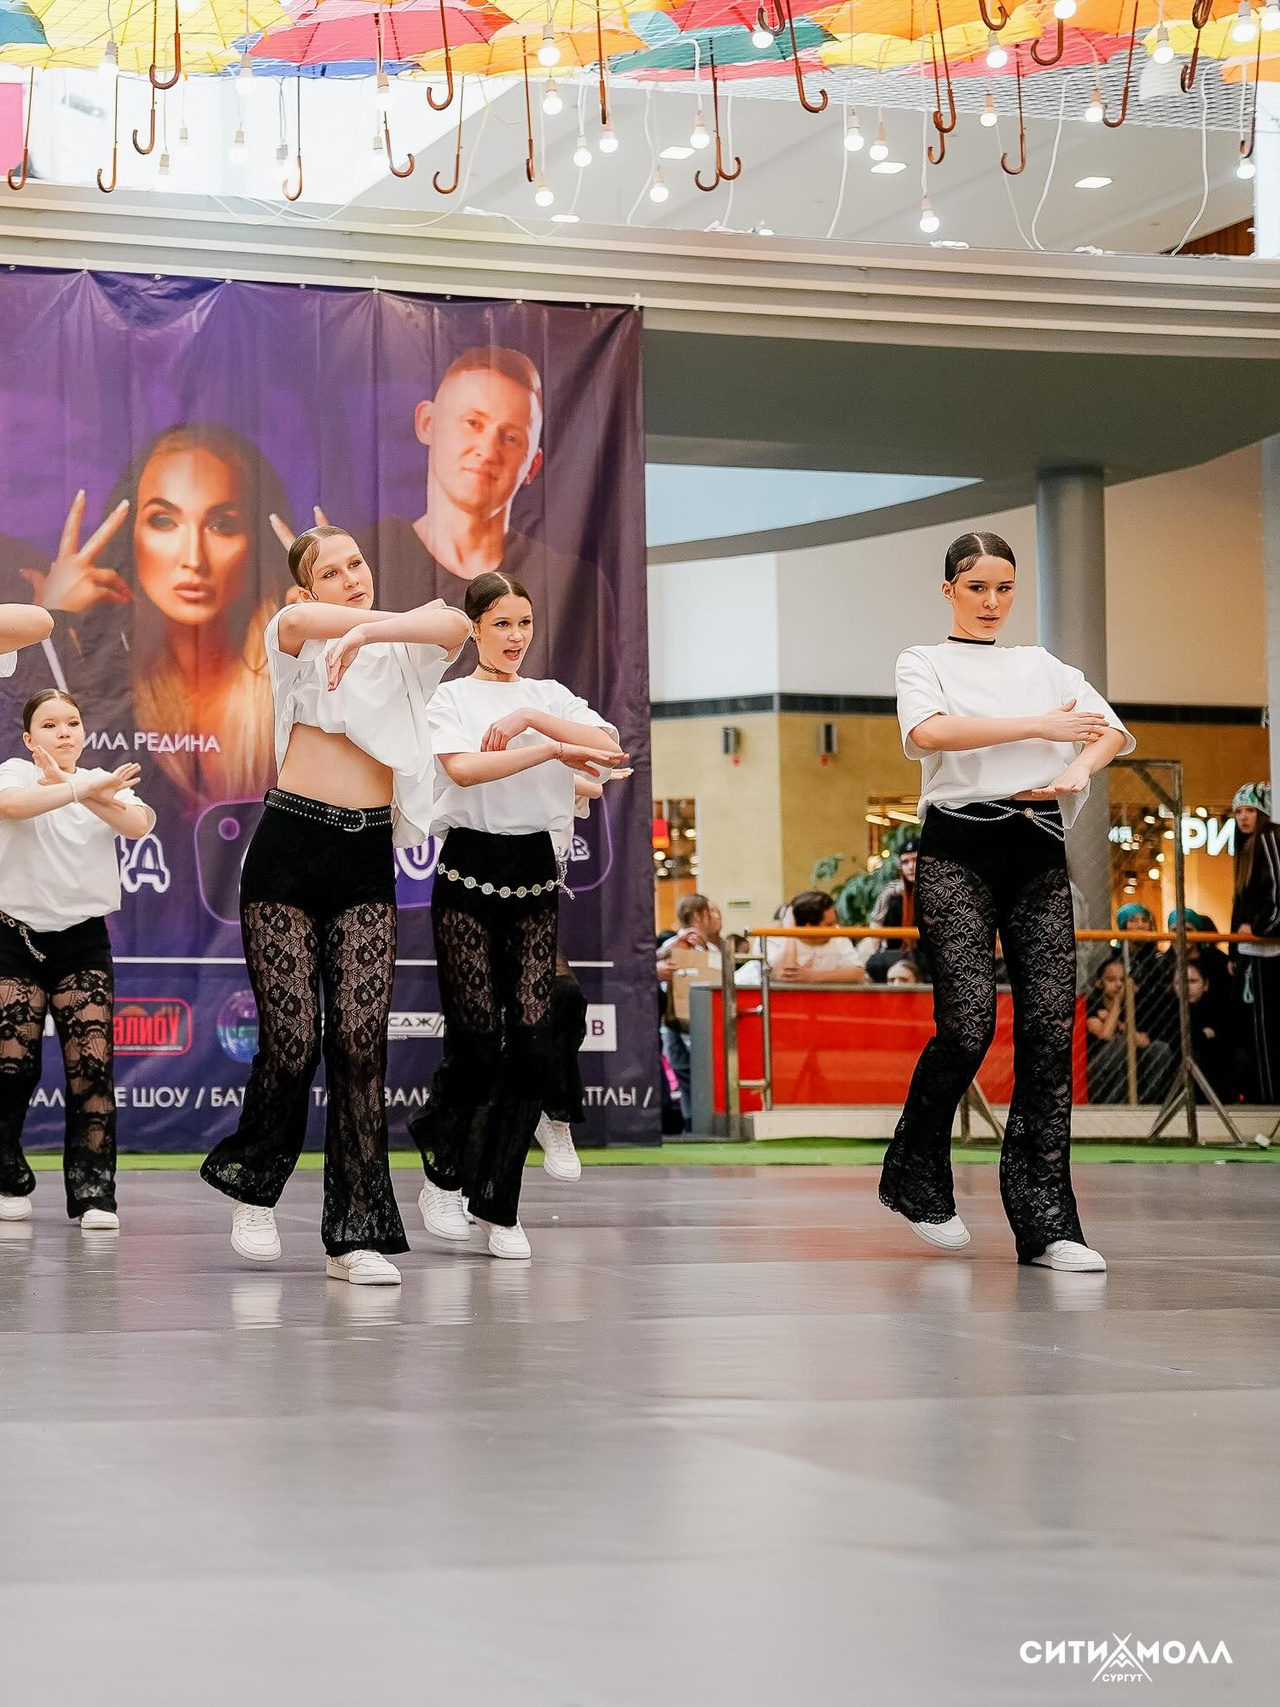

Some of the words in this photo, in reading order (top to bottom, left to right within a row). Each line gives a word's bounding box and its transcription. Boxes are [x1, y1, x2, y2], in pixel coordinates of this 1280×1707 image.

[84, 731, 129, 751] ИЛА
[134, 731, 220, 753] РЕДИНА
[113, 1008, 180, 1046] алибу
[389, 1017, 433, 1028] САЖ
[133, 1086, 190, 1108] ШОУ
